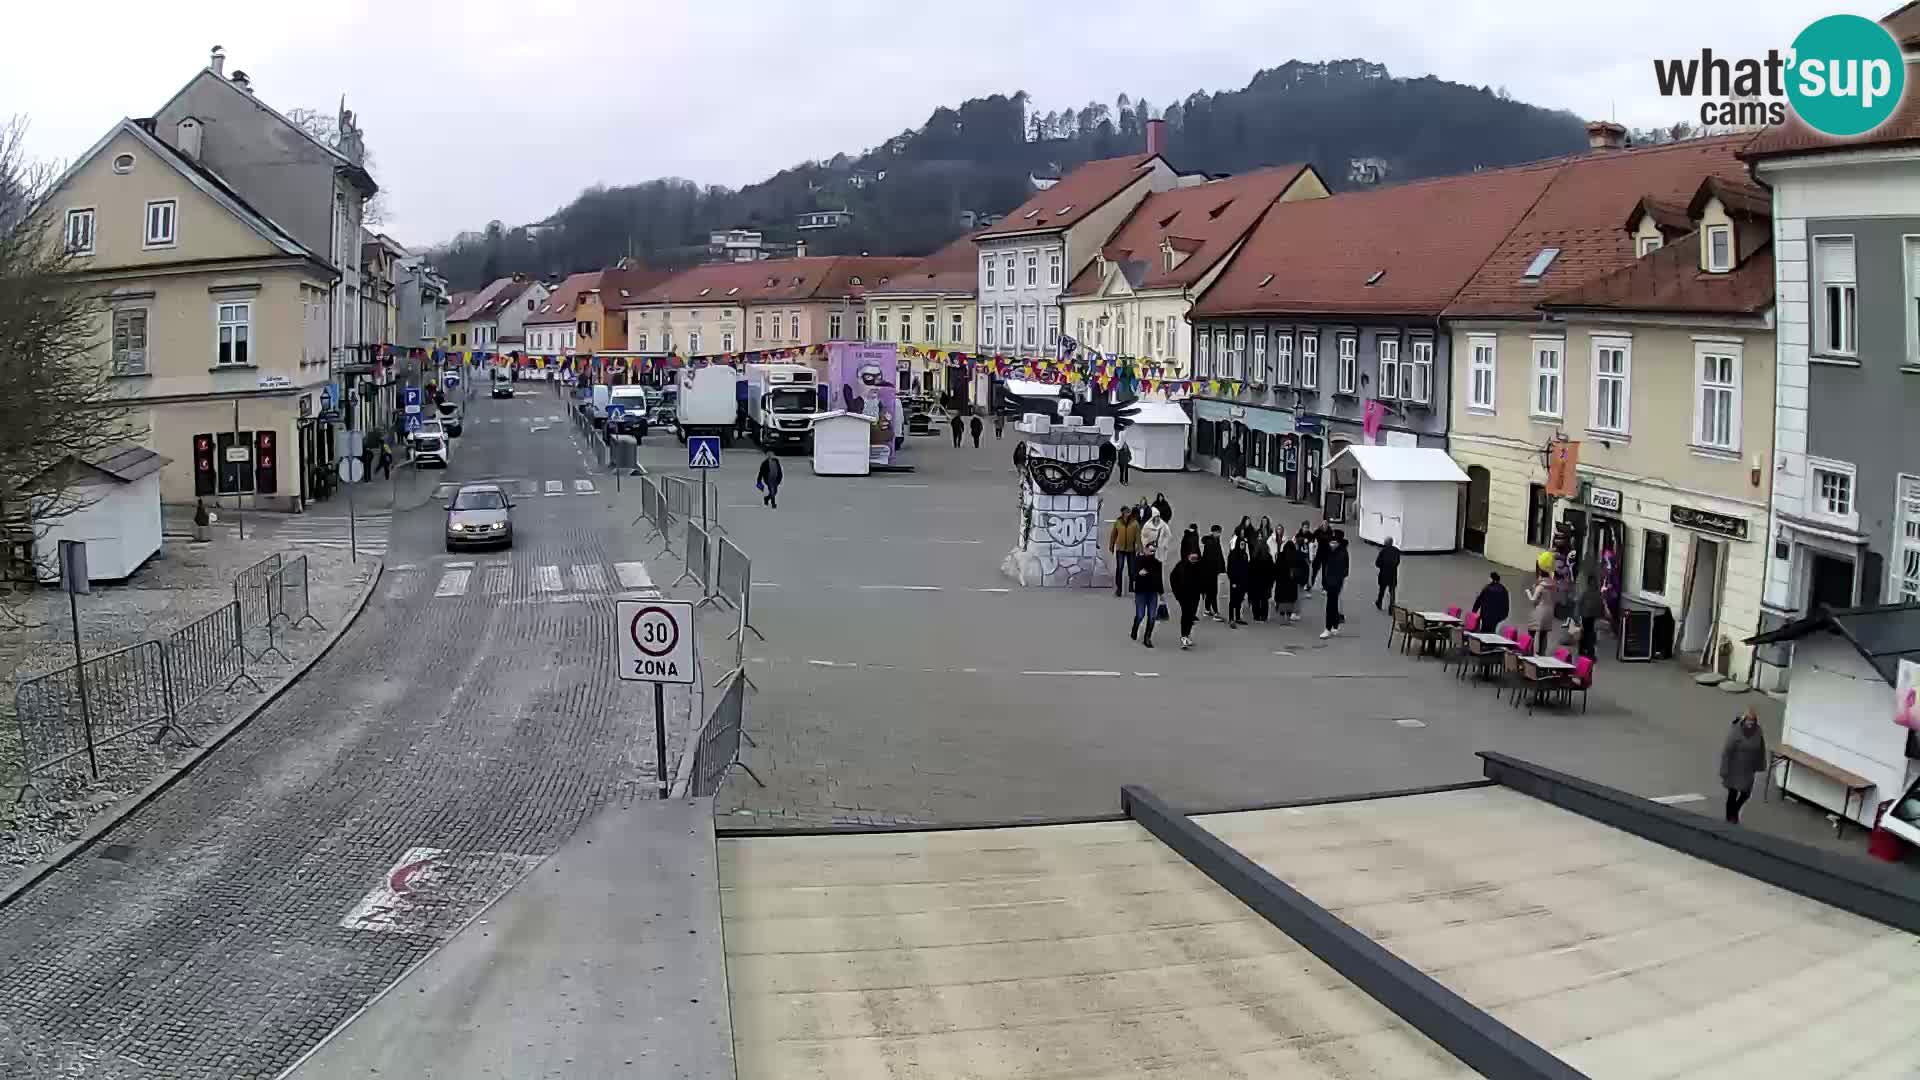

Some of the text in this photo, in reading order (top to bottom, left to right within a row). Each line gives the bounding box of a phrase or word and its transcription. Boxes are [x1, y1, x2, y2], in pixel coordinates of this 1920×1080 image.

[1048, 516, 1087, 545] 200
[643, 622, 668, 644] 30
[633, 659, 679, 677] ZONA
